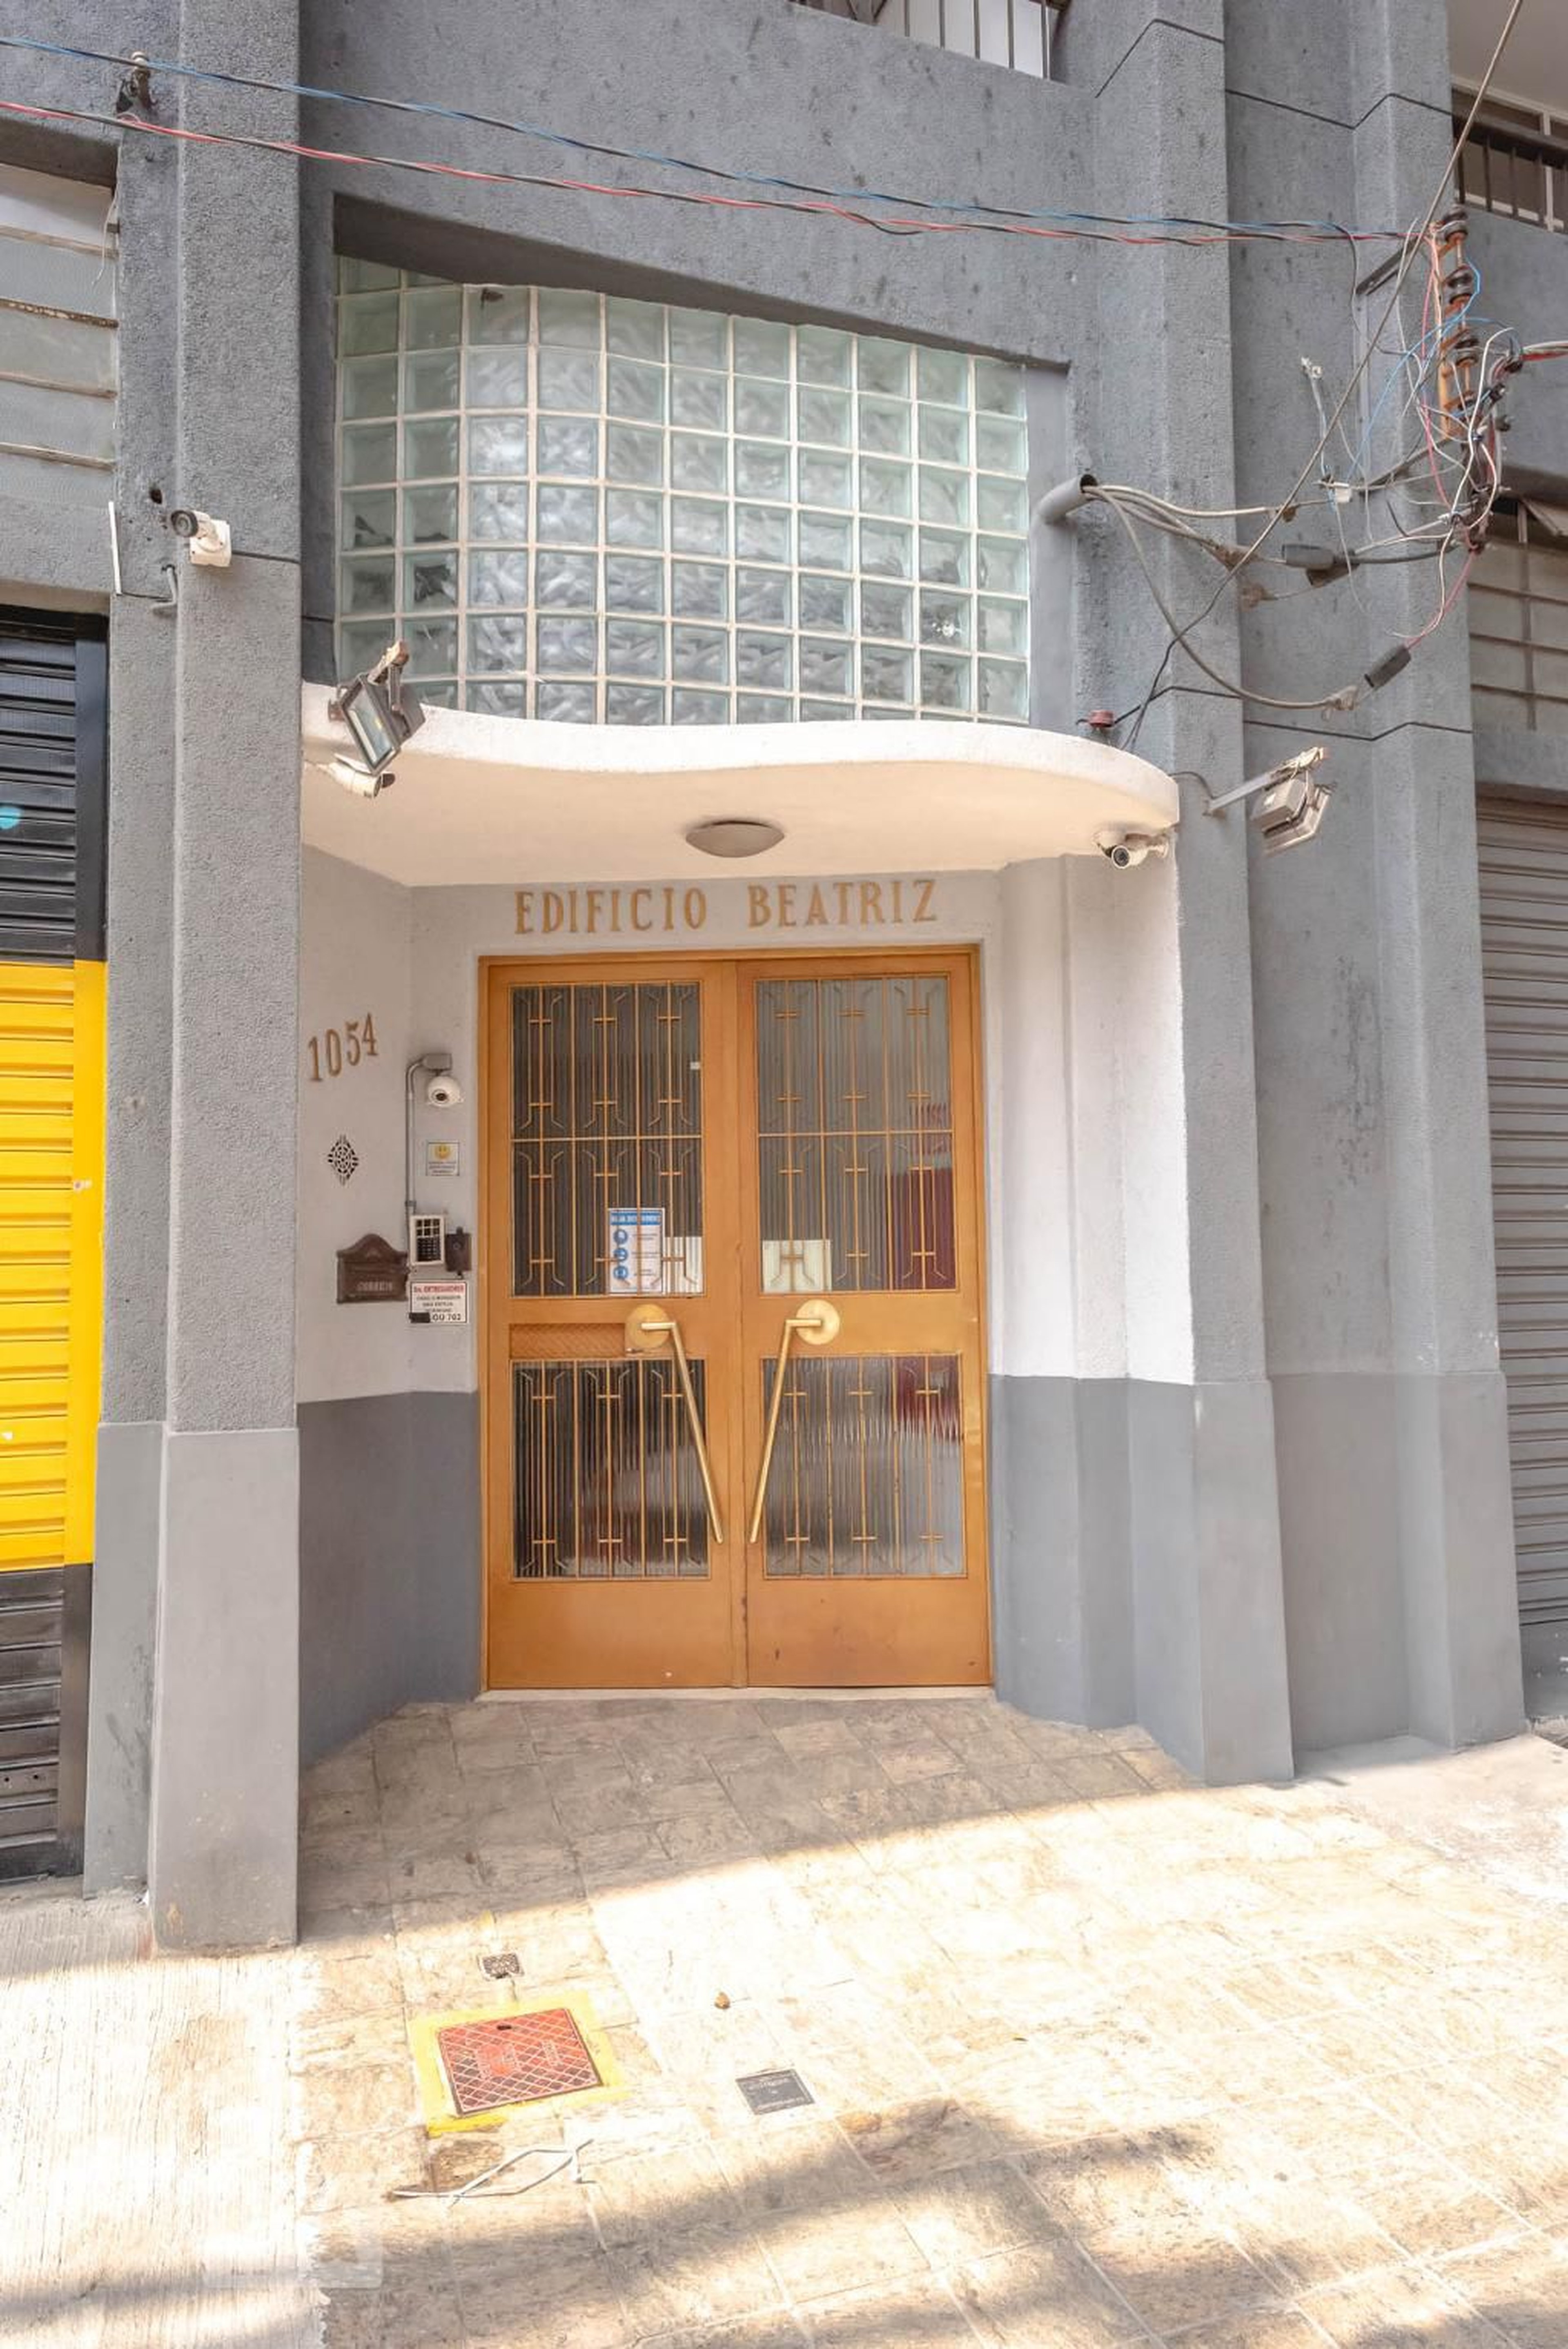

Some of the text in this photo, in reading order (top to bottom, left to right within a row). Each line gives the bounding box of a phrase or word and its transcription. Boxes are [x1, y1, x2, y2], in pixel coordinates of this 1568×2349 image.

[514, 879, 938, 935] EDIFICIO BEATRIZ
[309, 1012, 379, 1082] 1054
